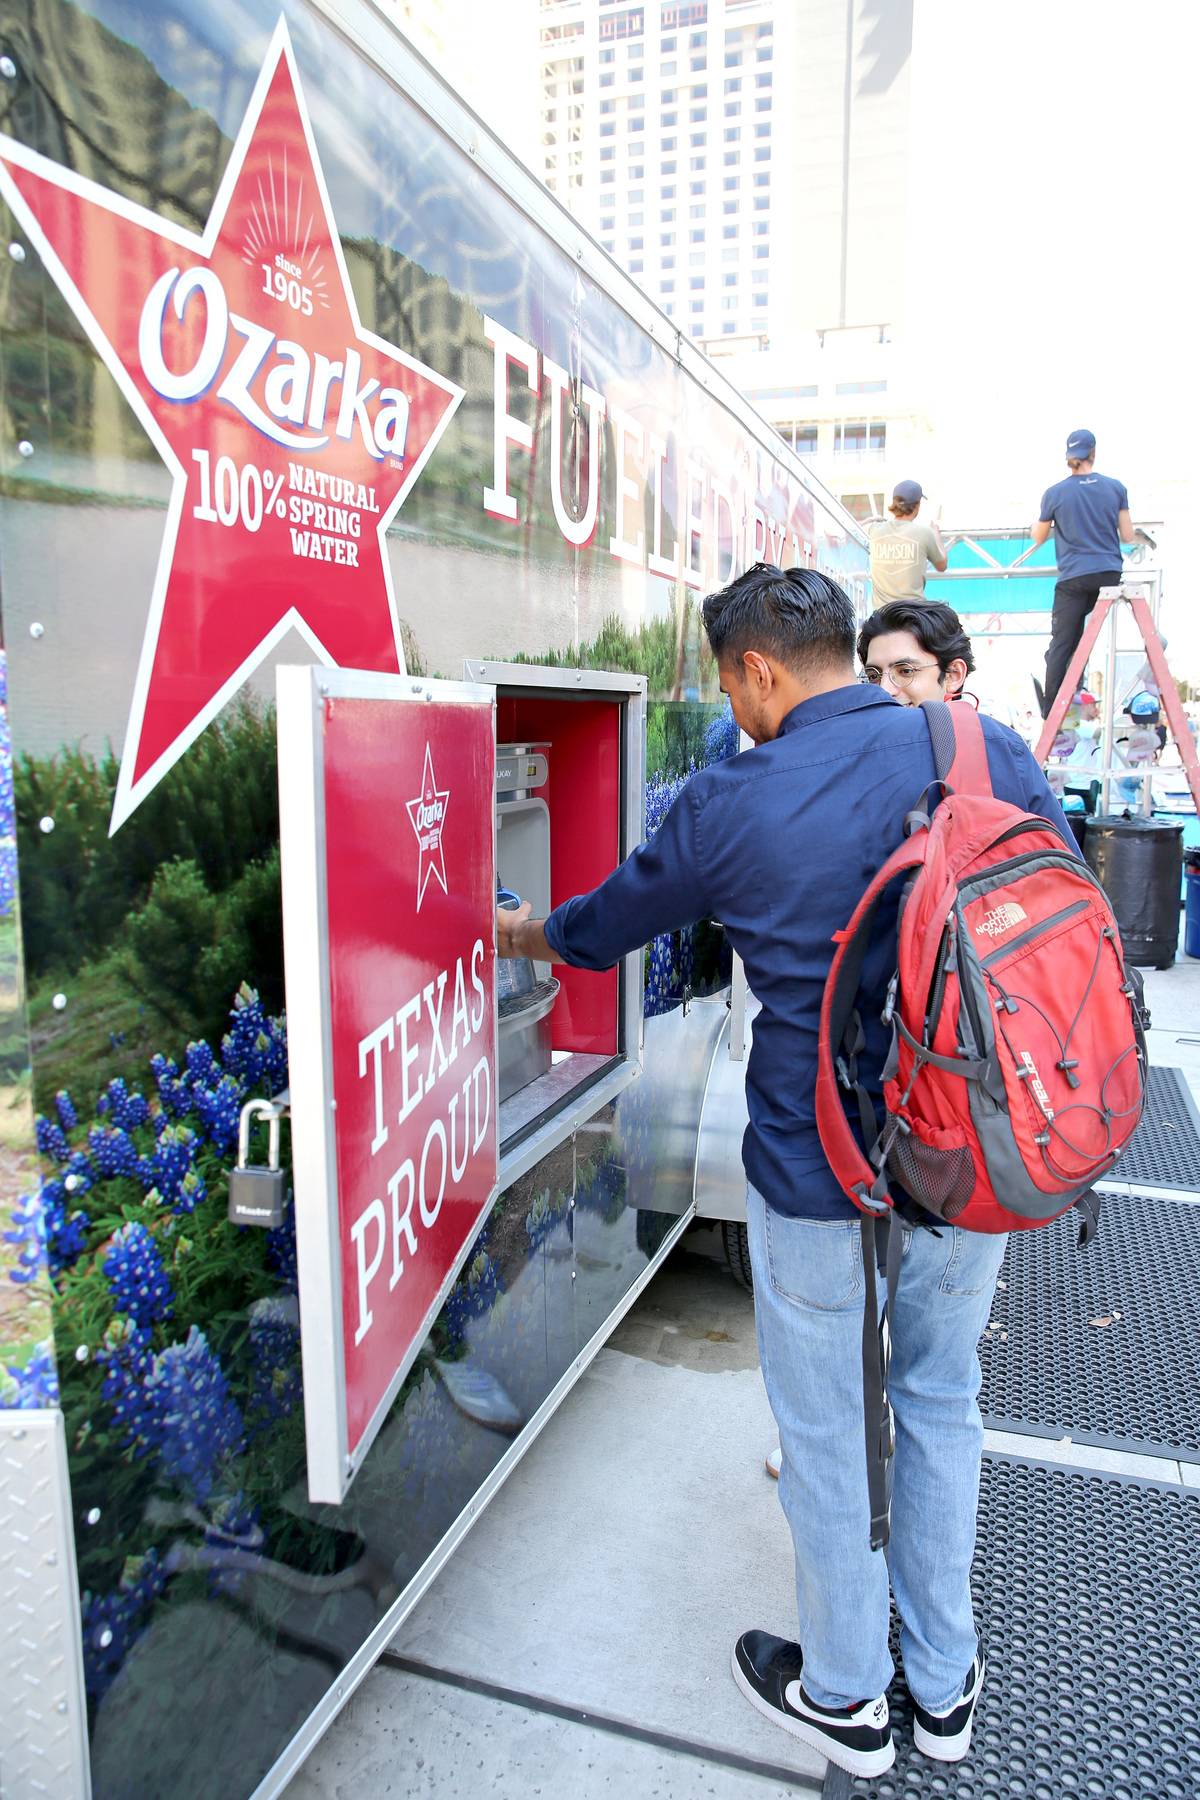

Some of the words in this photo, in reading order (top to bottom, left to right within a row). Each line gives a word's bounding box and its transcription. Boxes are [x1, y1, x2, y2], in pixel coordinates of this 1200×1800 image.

[275, 253, 302, 280] since
[261, 264, 314, 317] 1905
[138, 266, 410, 463] Ozarka
[192, 448, 287, 532] 100%
[288, 462, 380, 513] NATURAL
[288, 495, 361, 537] SPRING
[289, 527, 359, 567] WATER
[496, 769, 512, 779] LKAY
[975, 913, 1009, 936] NORTH
[984, 905, 1006, 920] THE
[988, 919, 1012, 938] FACE
[358, 938, 485, 1156] TEXAS
[350, 1055, 491, 1347] PROUD
